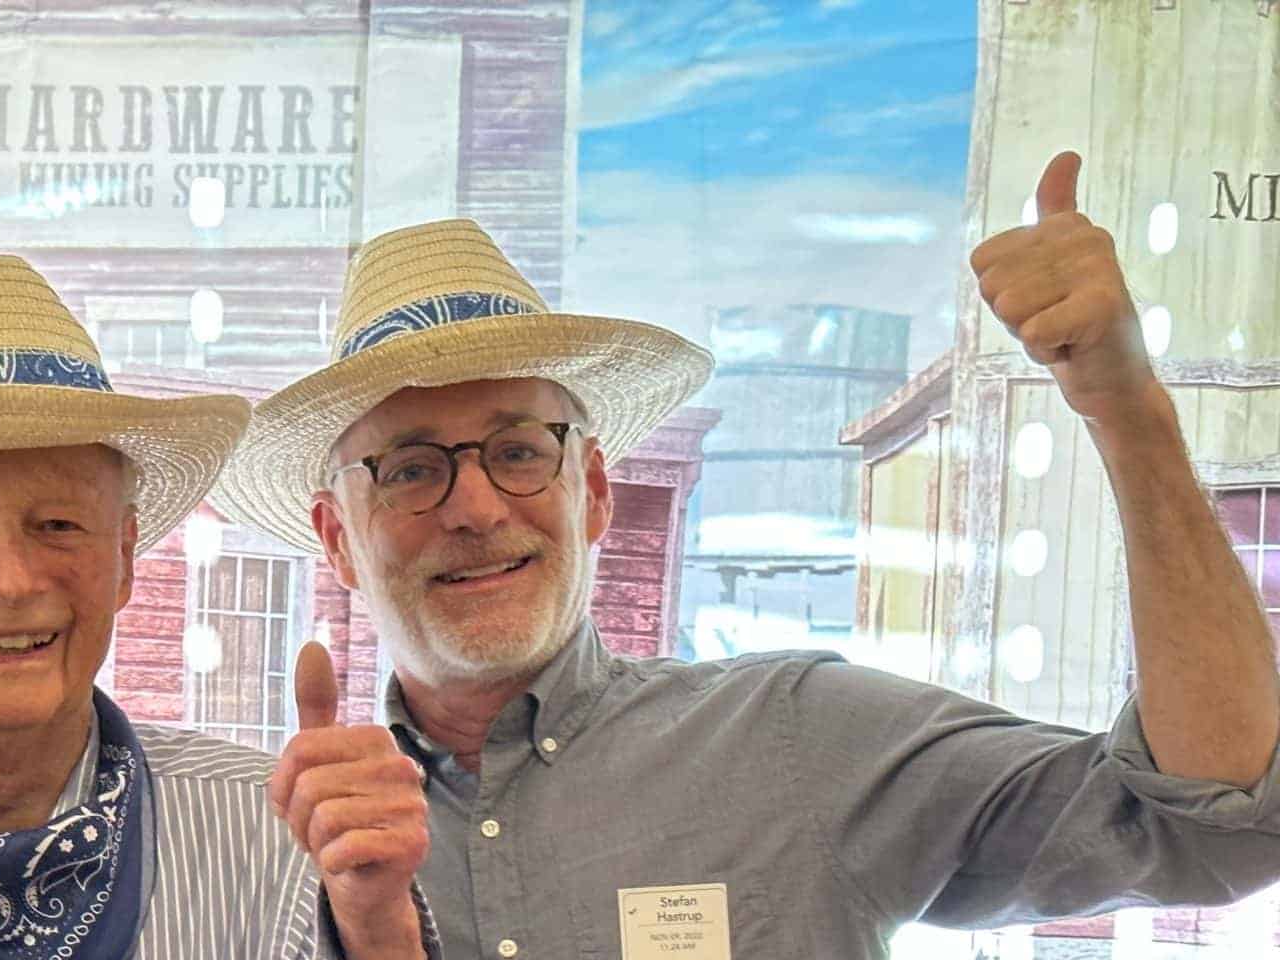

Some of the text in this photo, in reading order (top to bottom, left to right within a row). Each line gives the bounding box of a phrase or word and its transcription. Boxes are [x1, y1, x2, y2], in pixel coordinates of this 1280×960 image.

[172, 163, 354, 208] SPPLIES
[660, 895, 697, 908] Stefan
[656, 911, 704, 923] Hastrup
